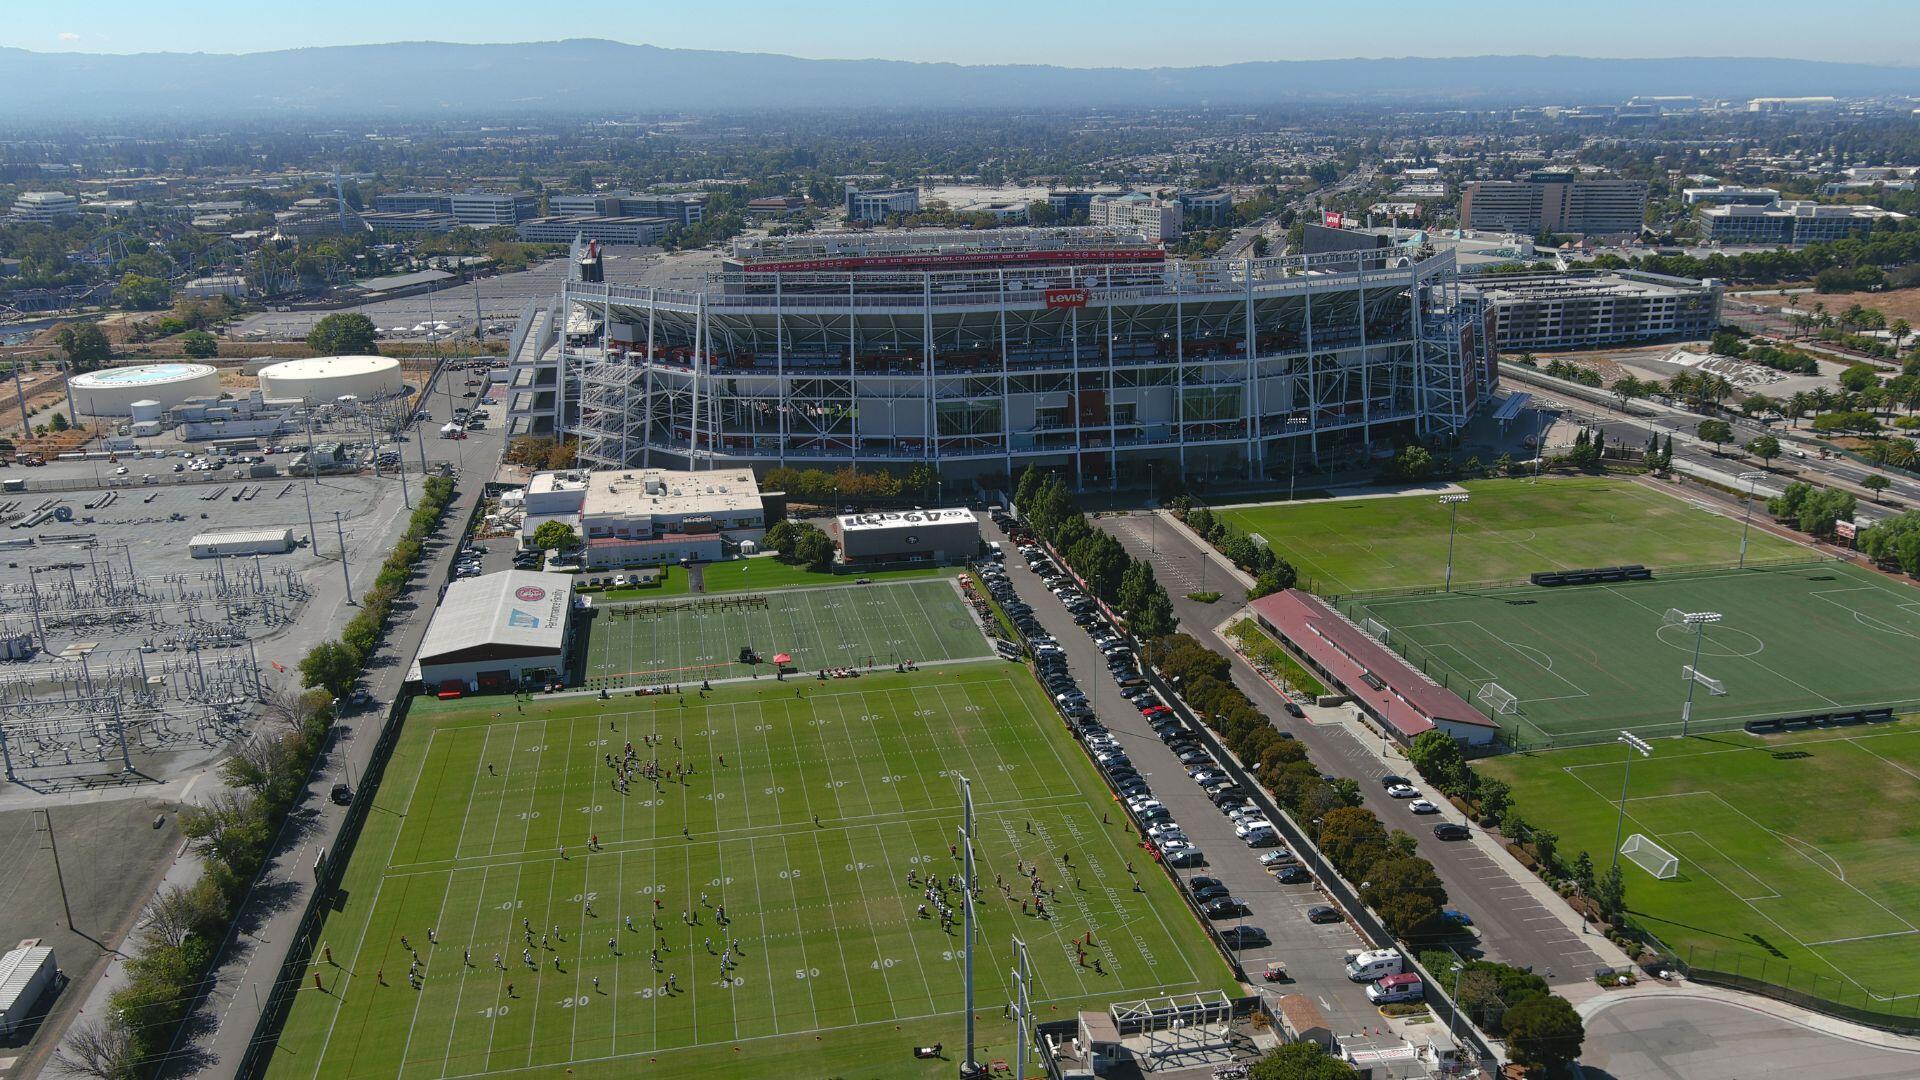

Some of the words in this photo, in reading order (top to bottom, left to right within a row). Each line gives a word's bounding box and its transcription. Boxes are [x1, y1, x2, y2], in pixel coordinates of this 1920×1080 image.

[1091, 290, 1141, 301] STADIUM
[938, 769, 959, 777] 20
[997, 764, 1015, 772] 10
[882, 775, 901, 783] 30
[825, 780, 844, 789] 40
[764, 786, 784, 795] 50
[705, 792, 725, 801] 40
[643, 799, 664, 807] 30
[582, 805, 602, 814] 20
[520, 812, 540, 820] 10
[910, 855, 930, 864] 30
[845, 862, 865, 872] 40
[780, 869, 800, 879] 50
[712, 877, 734, 887] 40
[643, 884, 666, 895] 30
[573, 892, 598, 903] 20
[502, 900, 524, 910] 10
[870, 958, 894, 970] 40
[795, 968, 820, 980] 50
[642, 986, 668, 999] 30
[562, 996, 589, 1008] 20
[484, 1005, 510, 1018] 10
